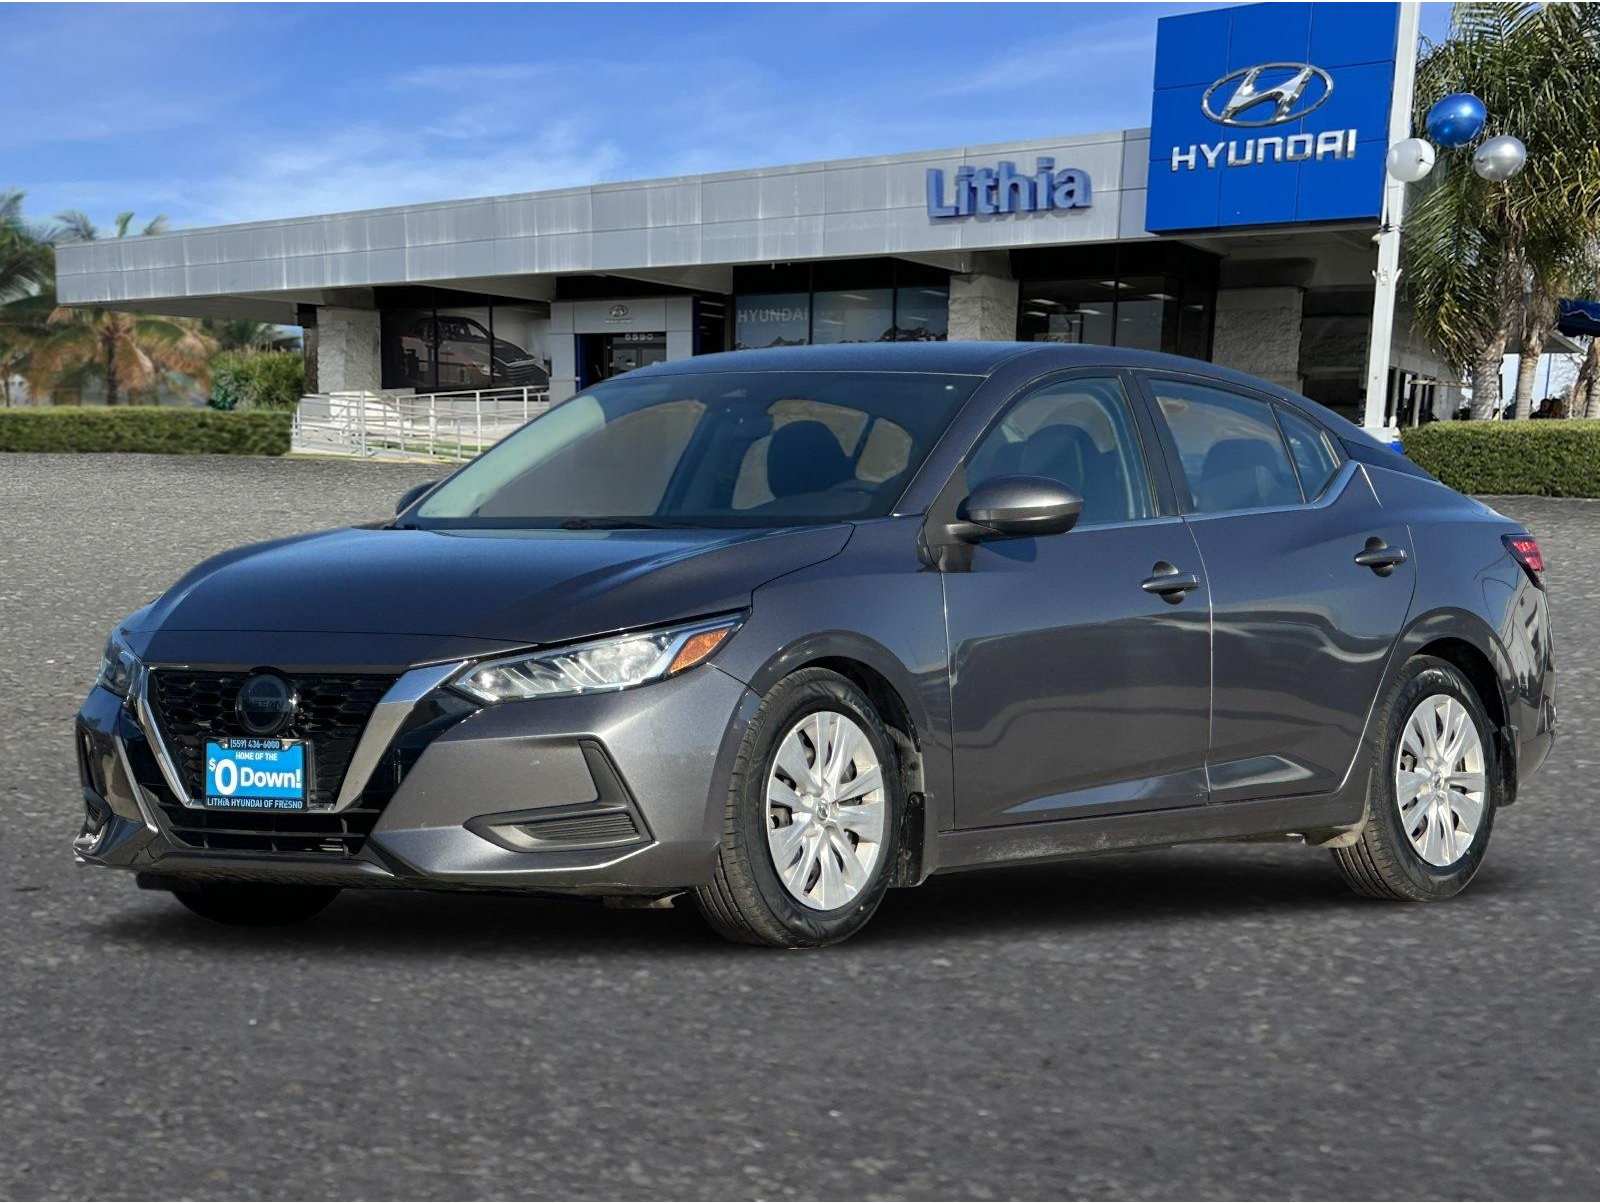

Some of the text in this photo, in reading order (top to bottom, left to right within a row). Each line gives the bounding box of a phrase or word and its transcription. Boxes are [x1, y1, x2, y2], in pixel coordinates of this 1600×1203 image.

[1171, 129, 1358, 172] HYUNDAI
[926, 156, 1093, 219] Lithia
[737, 307, 809, 322] HYUNDAI
[230, 739, 280, 749] (559) 436-6000
[235, 752, 278, 761] HOME OF THE
[240, 767, 302, 789] Down!
[207, 798, 303, 809] LITHIA HYUNDAI OF FRESNO
